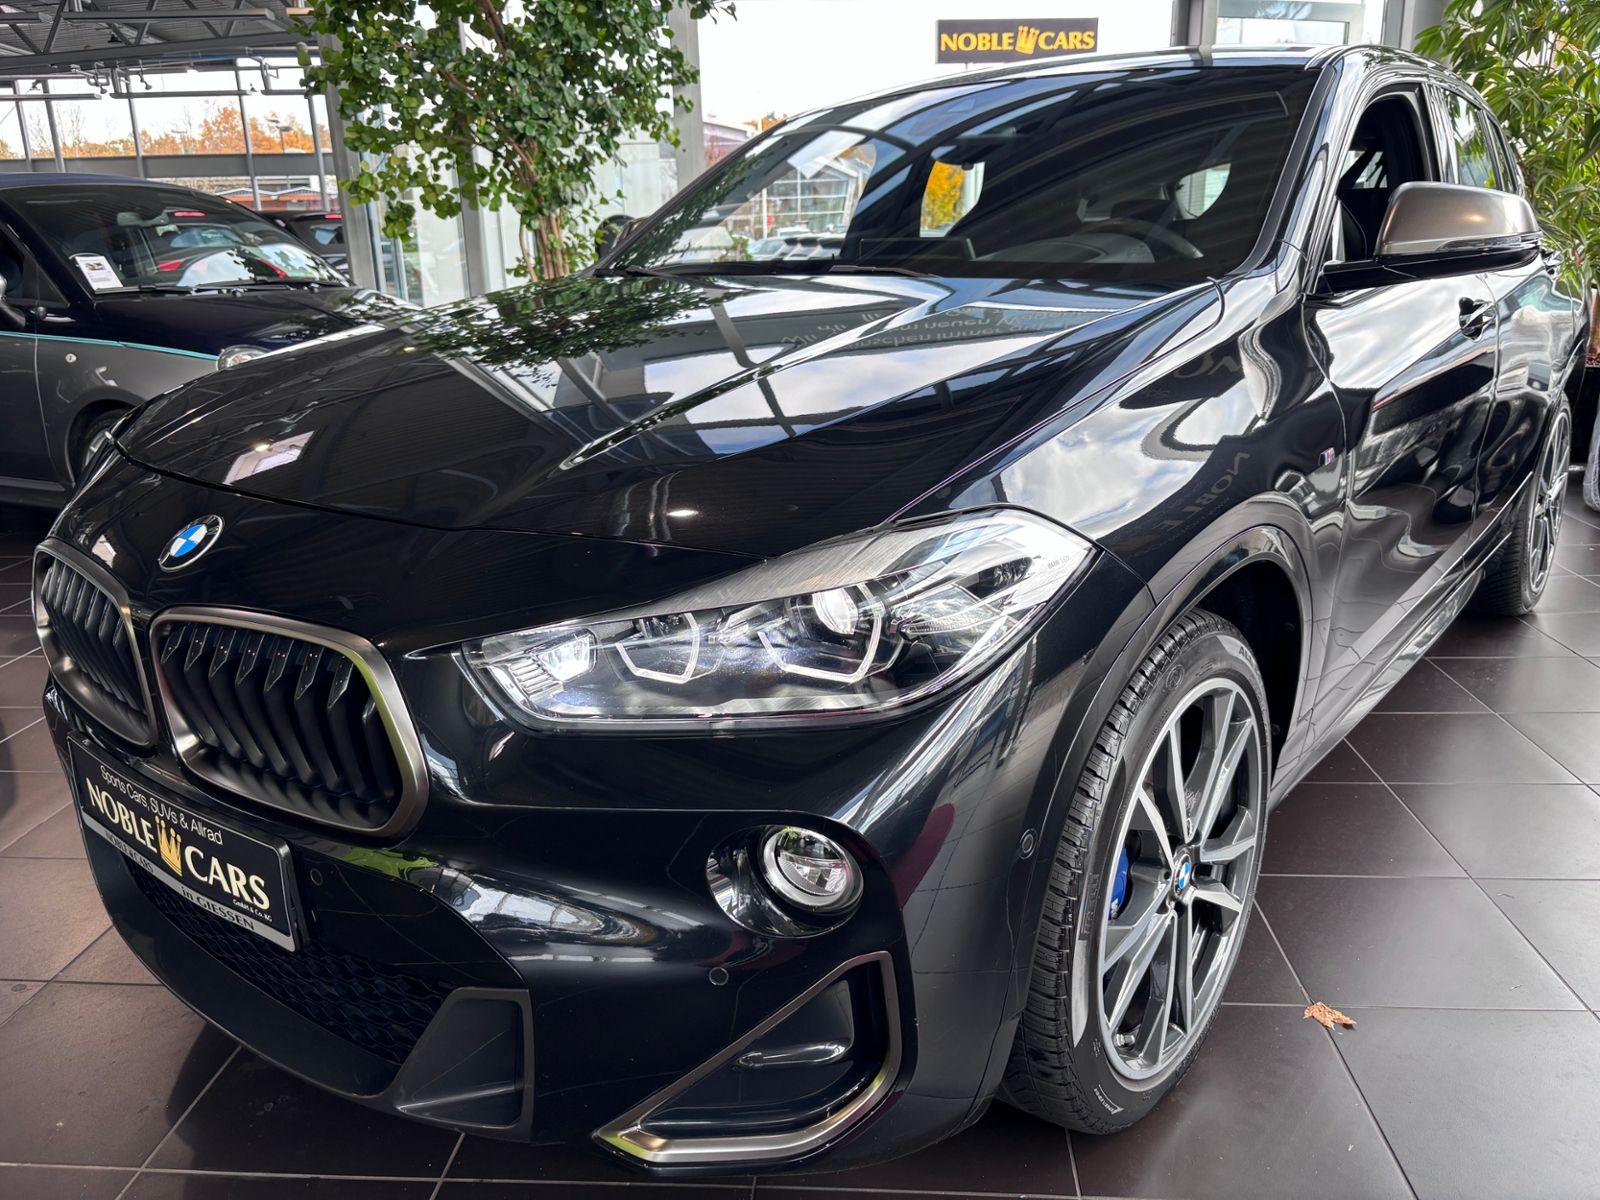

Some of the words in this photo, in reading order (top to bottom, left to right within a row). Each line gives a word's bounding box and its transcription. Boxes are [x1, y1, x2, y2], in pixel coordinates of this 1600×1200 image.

[940, 32, 1014, 52] NOBLE
[1037, 31, 1095, 50] CARS
[101, 765, 127, 795] Sports
[126, 783, 150, 812] Cars,
[150, 797, 178, 825] SUVs
[179, 813, 189, 830] &
[191, 818, 224, 846] Allrad
[86, 777, 158, 854] NOBLE
[184, 845, 270, 910] CARS
[181, 886, 193, 901] in
[197, 896, 255, 931] GIESSEN
